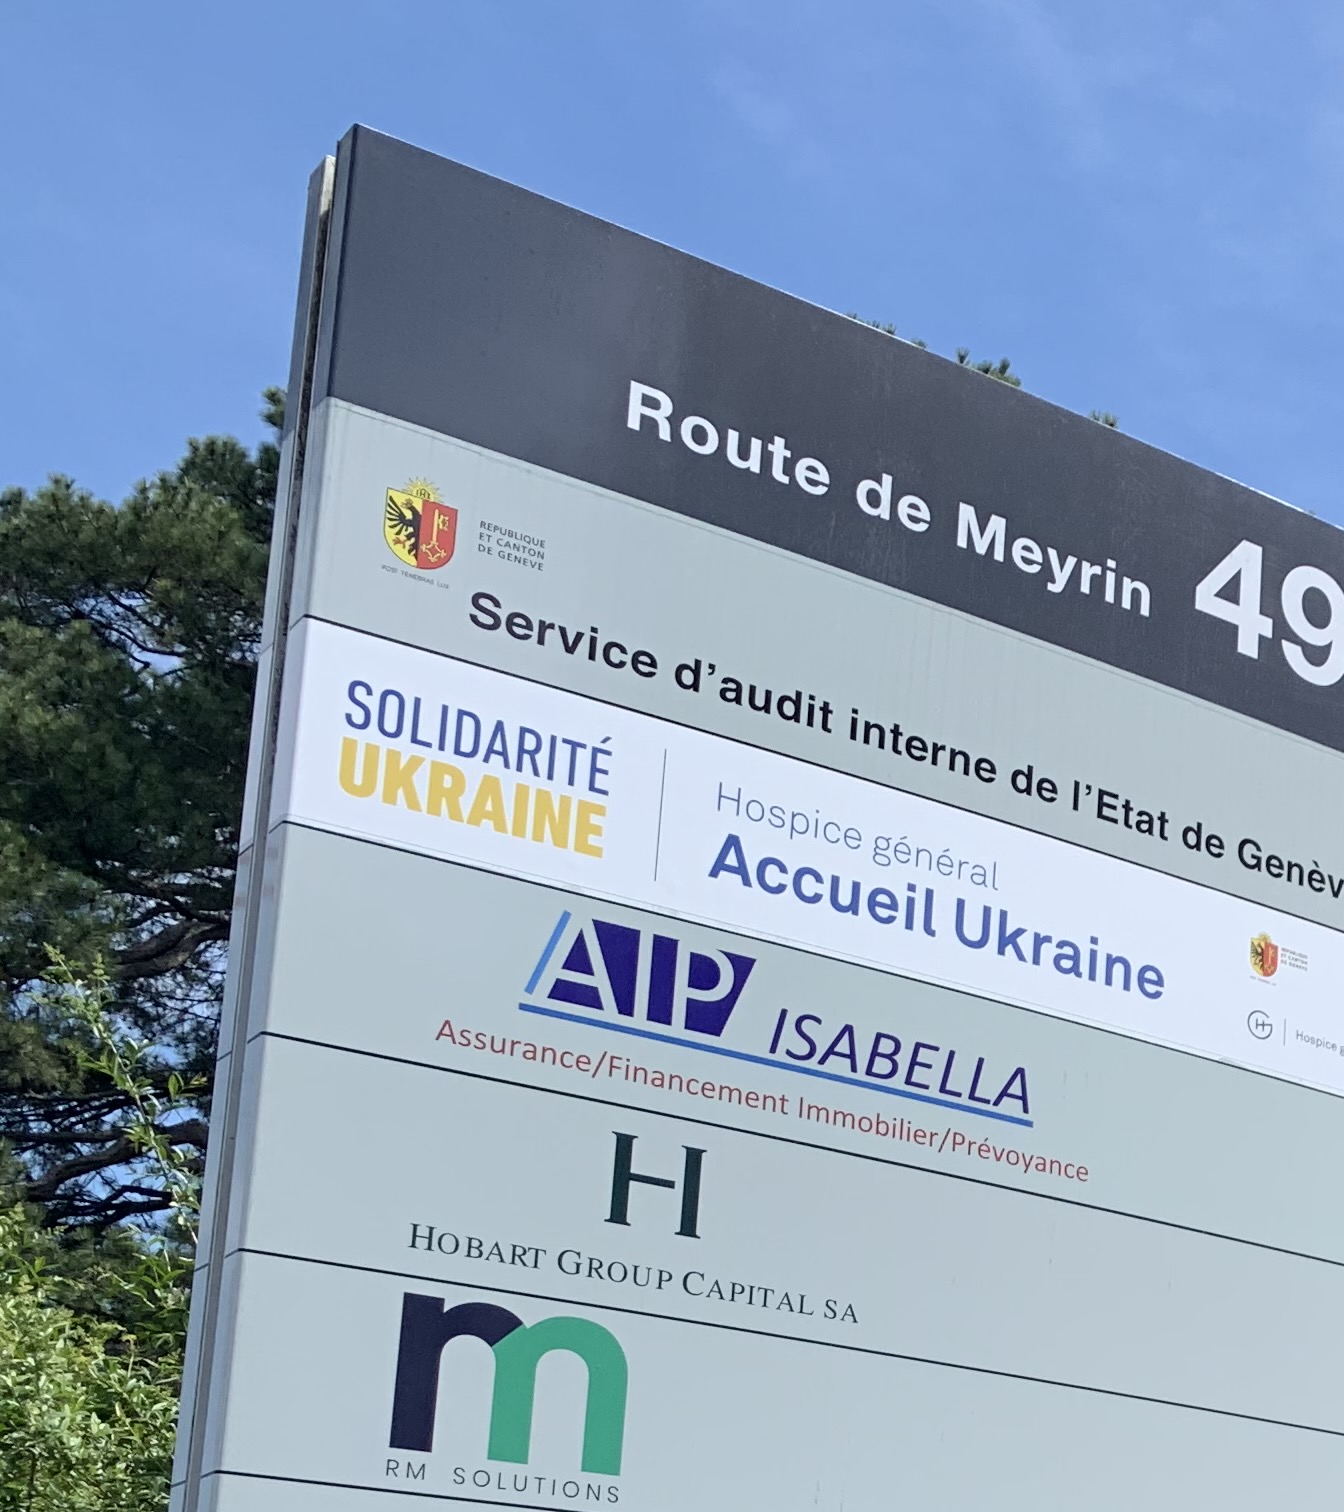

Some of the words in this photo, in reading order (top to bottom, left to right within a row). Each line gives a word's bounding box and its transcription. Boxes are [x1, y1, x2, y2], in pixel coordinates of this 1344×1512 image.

[479, 532, 492, 544] ET
[496, 538, 545, 560] CANTON
[480, 520, 546, 548] REPUBLIQUE
[627, 380, 830, 496] Route
[856, 472, 932, 533] de
[957, 502, 1151, 618] Meyrin
[478, 544, 492, 556] DE
[498, 550, 544, 571] GENEVE
[345, 680, 613, 798] SOLIDARITÉ
[468, 592, 659, 679] Service
[674, 658, 834, 734] d'audit
[850, 709, 997, 784] interne
[1010, 765, 1059, 804] de
[1072, 780, 1170, 842] l'Etat
[1182, 821, 1226, 860] de
[338, 737, 608, 859] UKRAINE
[717, 780, 863, 850] Hospice
[872, 834, 999, 892] général
[707, 833, 937, 938] Accueil
[955, 898, 1165, 1000] Ukraine
[769, 1008, 1030, 1115] ISABELLA
[1296, 1030, 1337, 1052] Hospice
[435, 1020, 789, 1116] Assurance/Financement
[797, 1096, 1089, 1183] Immobilier/Prévoyance
[604, 1131, 707, 1240] H
[408, 1223, 547, 1270] HOBART
[557, 1250, 673, 1290] GROUP
[682, 1271, 815, 1316] CAPITAL
[823, 1299, 859, 1324] SA
[386, 1459, 427, 1481] RM
[453, 1467, 620, 1504] SOLUTIONS
